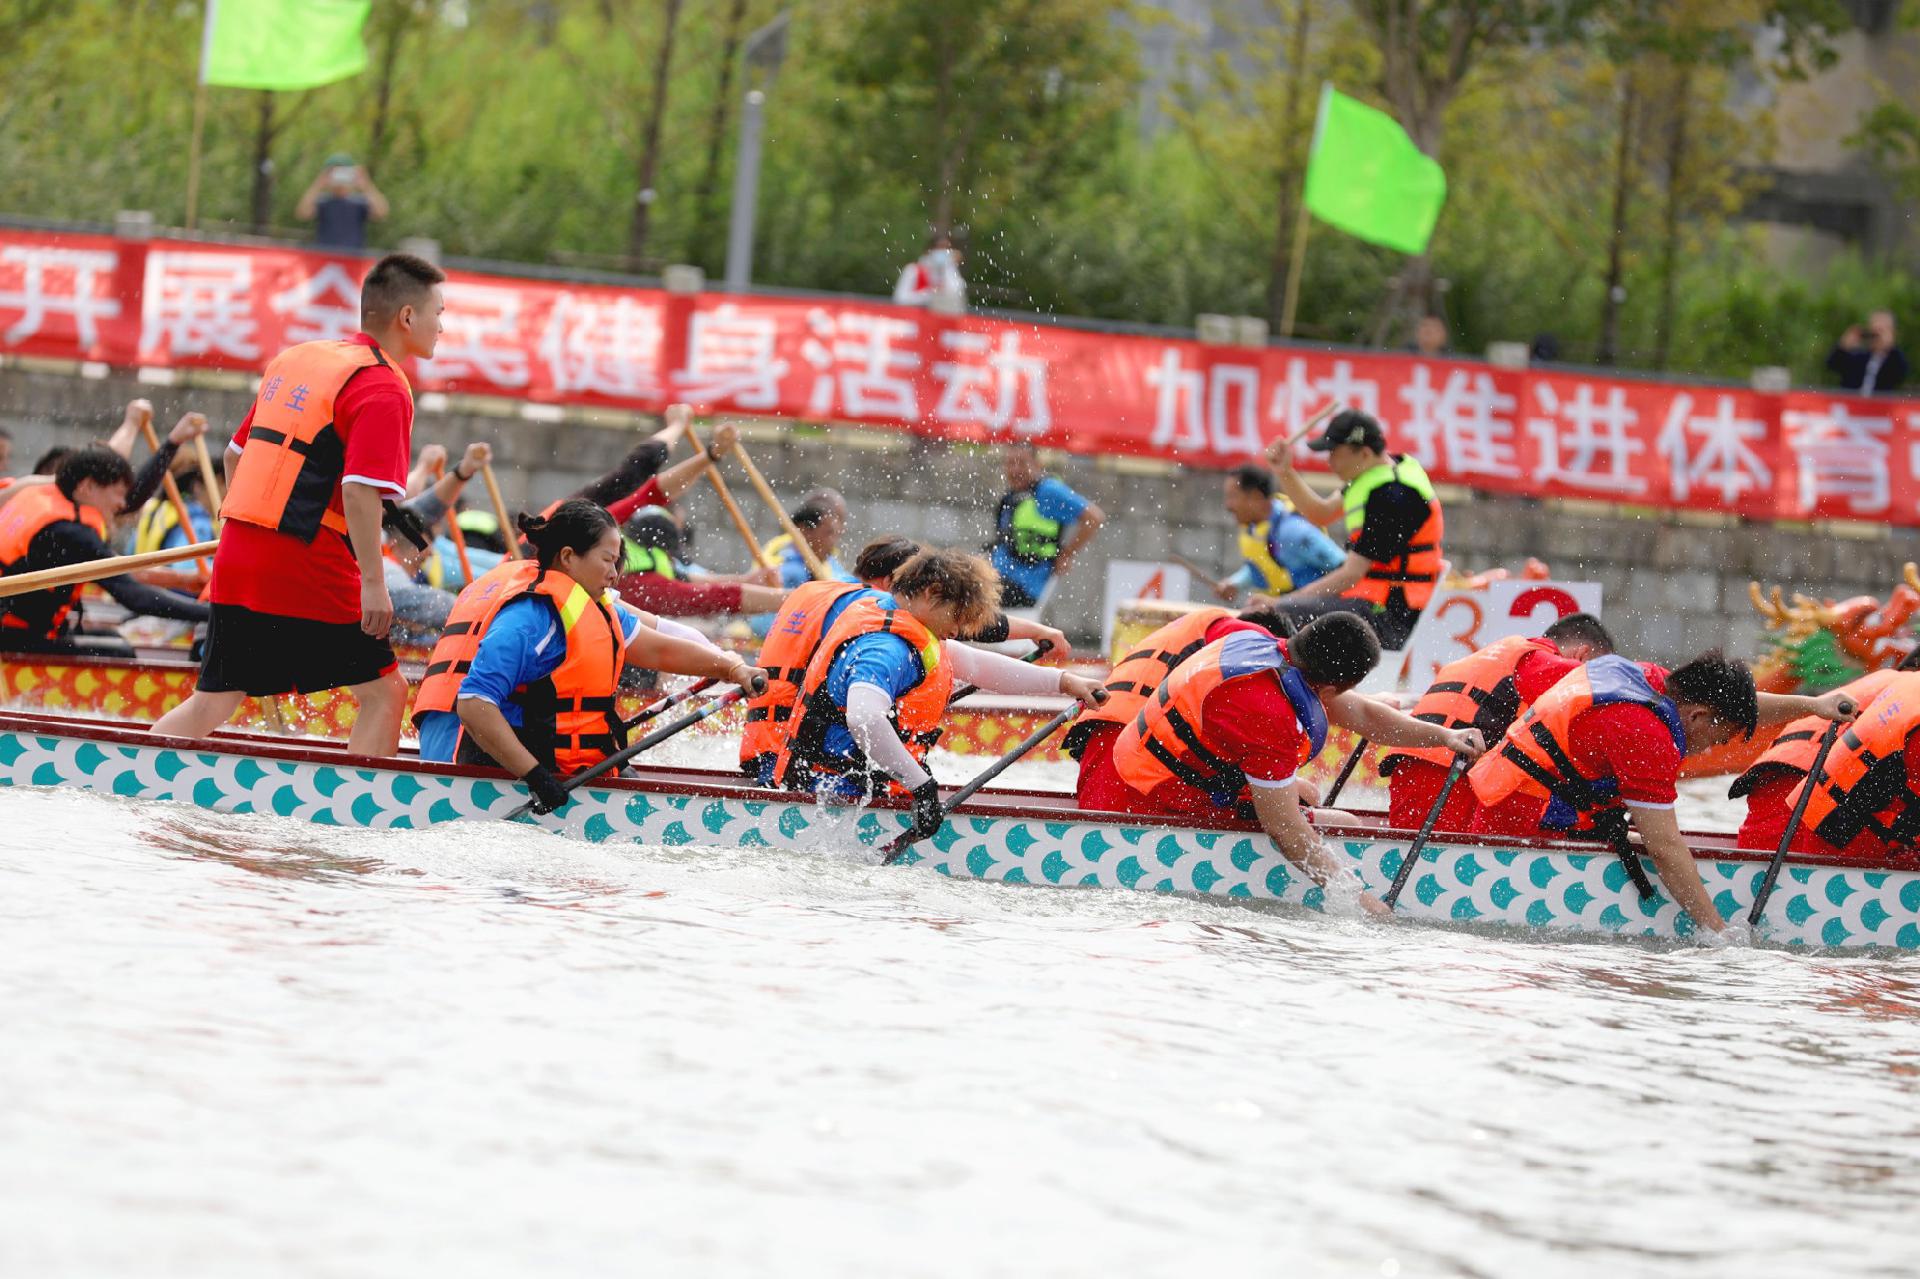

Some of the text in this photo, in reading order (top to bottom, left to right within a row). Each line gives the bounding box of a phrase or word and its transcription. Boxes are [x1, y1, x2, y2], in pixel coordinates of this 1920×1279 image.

[1146, 345, 1920, 515] 加快推进体育
